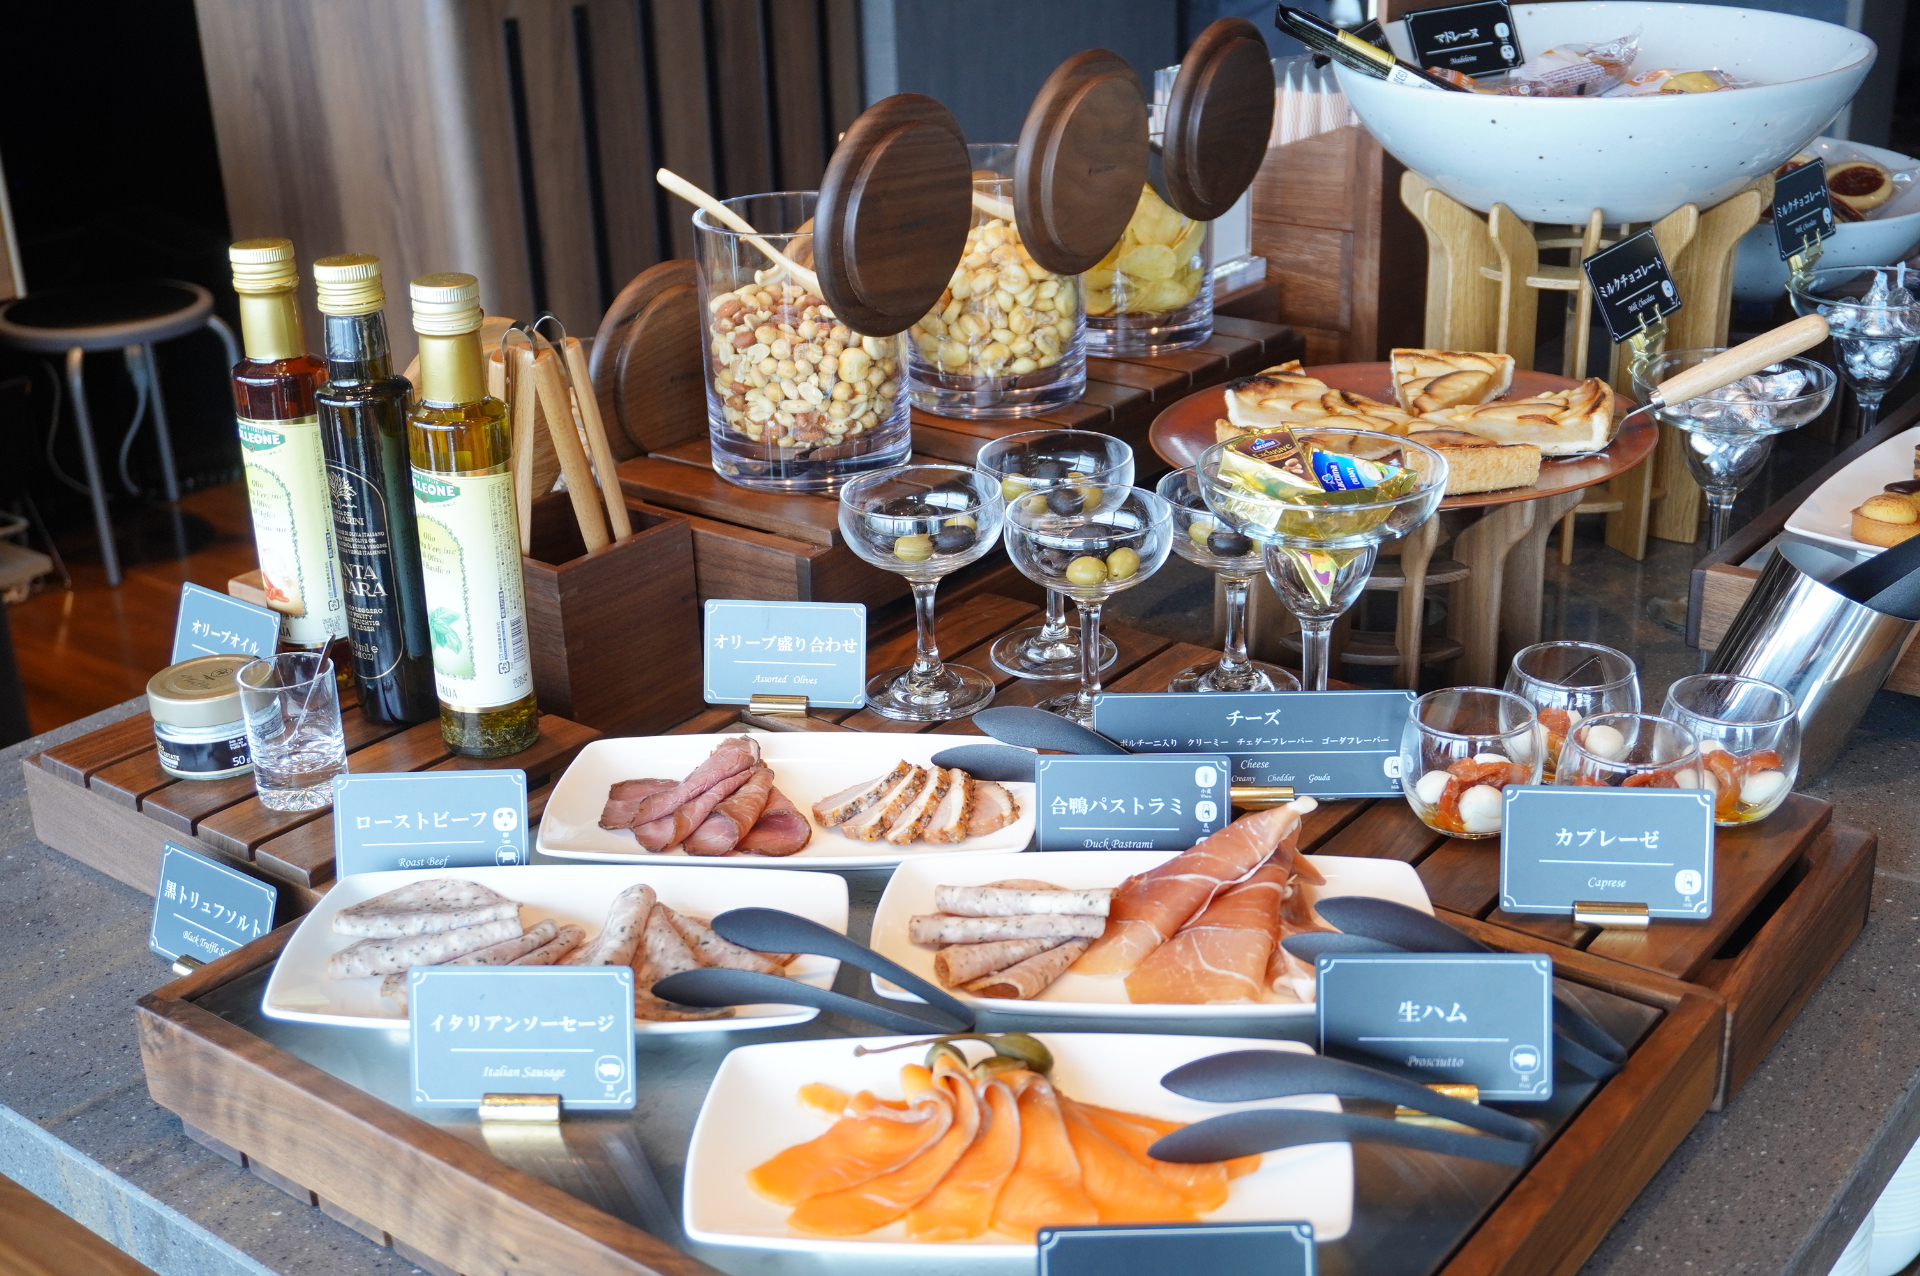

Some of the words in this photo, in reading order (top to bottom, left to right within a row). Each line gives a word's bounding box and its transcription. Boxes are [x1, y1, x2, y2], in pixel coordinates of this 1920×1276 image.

[1434, 28, 1479, 43] マドレーヌ
[1777, 185, 1827, 218] ミルクチョコレート
[1599, 257, 1662, 298] ミルクチョコレート
[1252, 443, 1293, 458] Exclusive
[423, 532, 436, 541] Olio
[354, 606, 383, 614] LEGGERO
[713, 634, 859, 654] オリーブ盛り合わせ
[752, 675, 789, 684] Assorted
[793, 675, 818, 685] Olives
[1225, 709, 1281, 727] チーズ
[1120, 739, 1177, 748] ポルチーニ入り
[1187, 738, 1229, 747] クリーミー
[1236, 737, 1314, 746] チェダーフレーバー
[1321, 736, 1390, 745] ゴーダフレーバー
[233, 755, 246, 766] 50
[1240, 759, 1270, 770] Cheese
[1231, 775, 1256, 784] Creamy
[1267, 773, 1296, 782] Cheddar
[1308, 773, 1331, 784] Gouda
[1050, 796, 1182, 816] 合鴨パストラミ
[355, 811, 488, 830] ローストビーフ
[1083, 838, 1111, 850] Duck
[1111, 838, 1154, 849] Pastrami
[1555, 828, 1660, 849] カプレーゼ
[398, 857, 425, 868] Roast
[427, 855, 450, 869] Beef
[1587, 877, 1627, 890] Caprese
[164, 880, 261, 938] 黒トリュフソルト
[183, 930, 200, 947] Black
[200, 937, 219, 953] Truffle
[1397, 1000, 1468, 1023] 生ハム
[429, 1014, 615, 1032] イタリアンソーセージ
[1407, 1055, 1464, 1068] Prosciutto
[482, 1065, 520, 1078] Italian
[521, 1066, 567, 1081] Sausage
